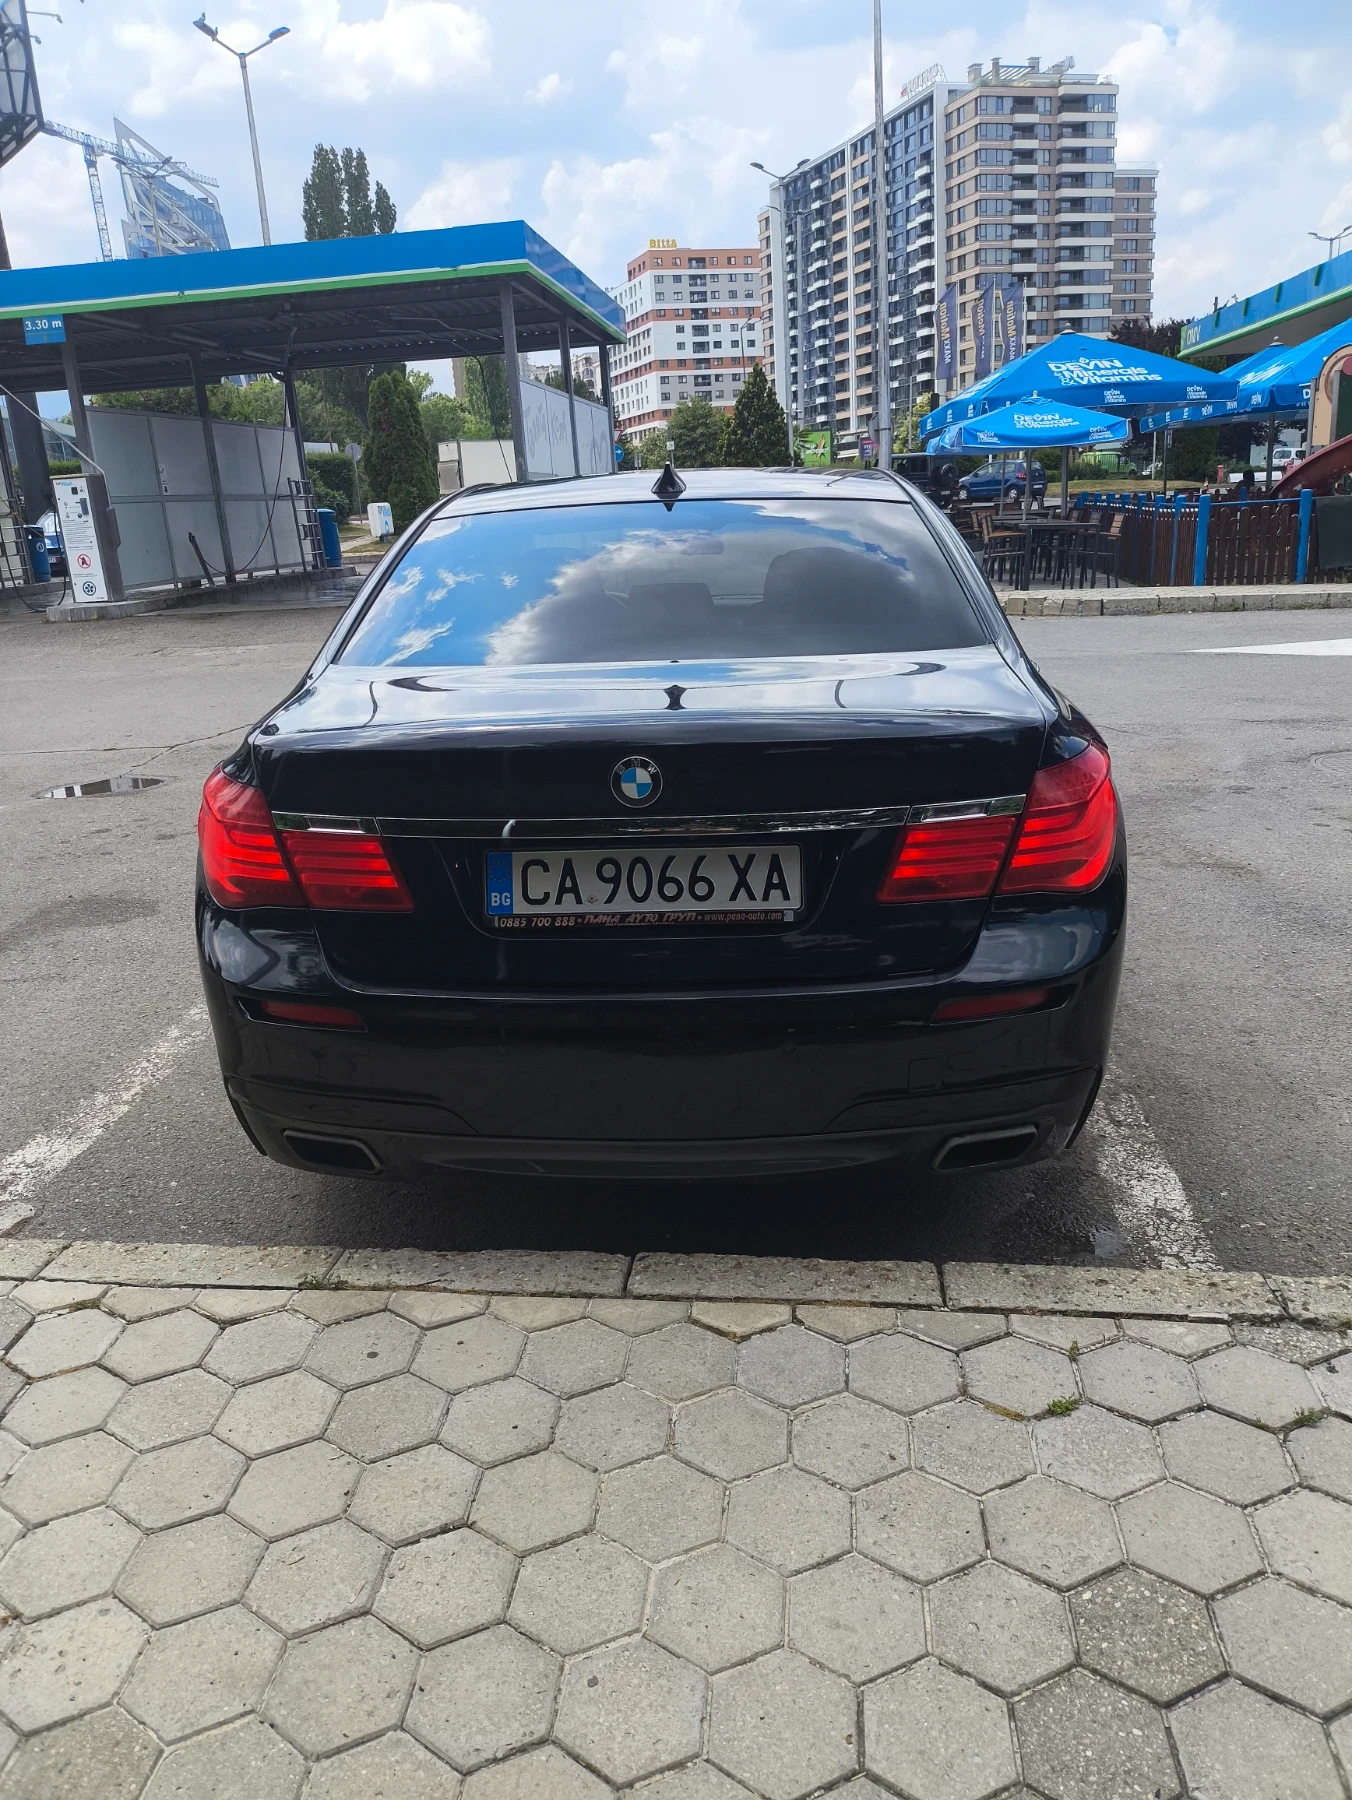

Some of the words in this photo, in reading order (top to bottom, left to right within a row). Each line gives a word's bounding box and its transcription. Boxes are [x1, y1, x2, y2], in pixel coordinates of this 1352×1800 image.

[649, 238, 678, 249] BILLA
[25, 319, 48, 331] 3.30
[52, 320, 62, 329] m
[1047, 358, 1124, 372] DEVIN
[1064, 366, 1148, 378] Minerals
[1073, 374, 1163, 385] Vitamins
[1013, 413, 1060, 421] DEVIN
[616, 758, 658, 775] BMW
[520, 858, 584, 906] CA
[595, 855, 715, 905] 9066
[727, 853, 791, 902] XA
[490, 892, 511, 907] BG
[499, 917, 527, 928] 0885
[531, 916, 551, 927] 700
[554, 916, 576, 927] 888
[625, 912, 659, 924] АУТО
[662, 912, 697, 922] ГРУП
[704, 911, 783, 924] www.pana-auto.com
